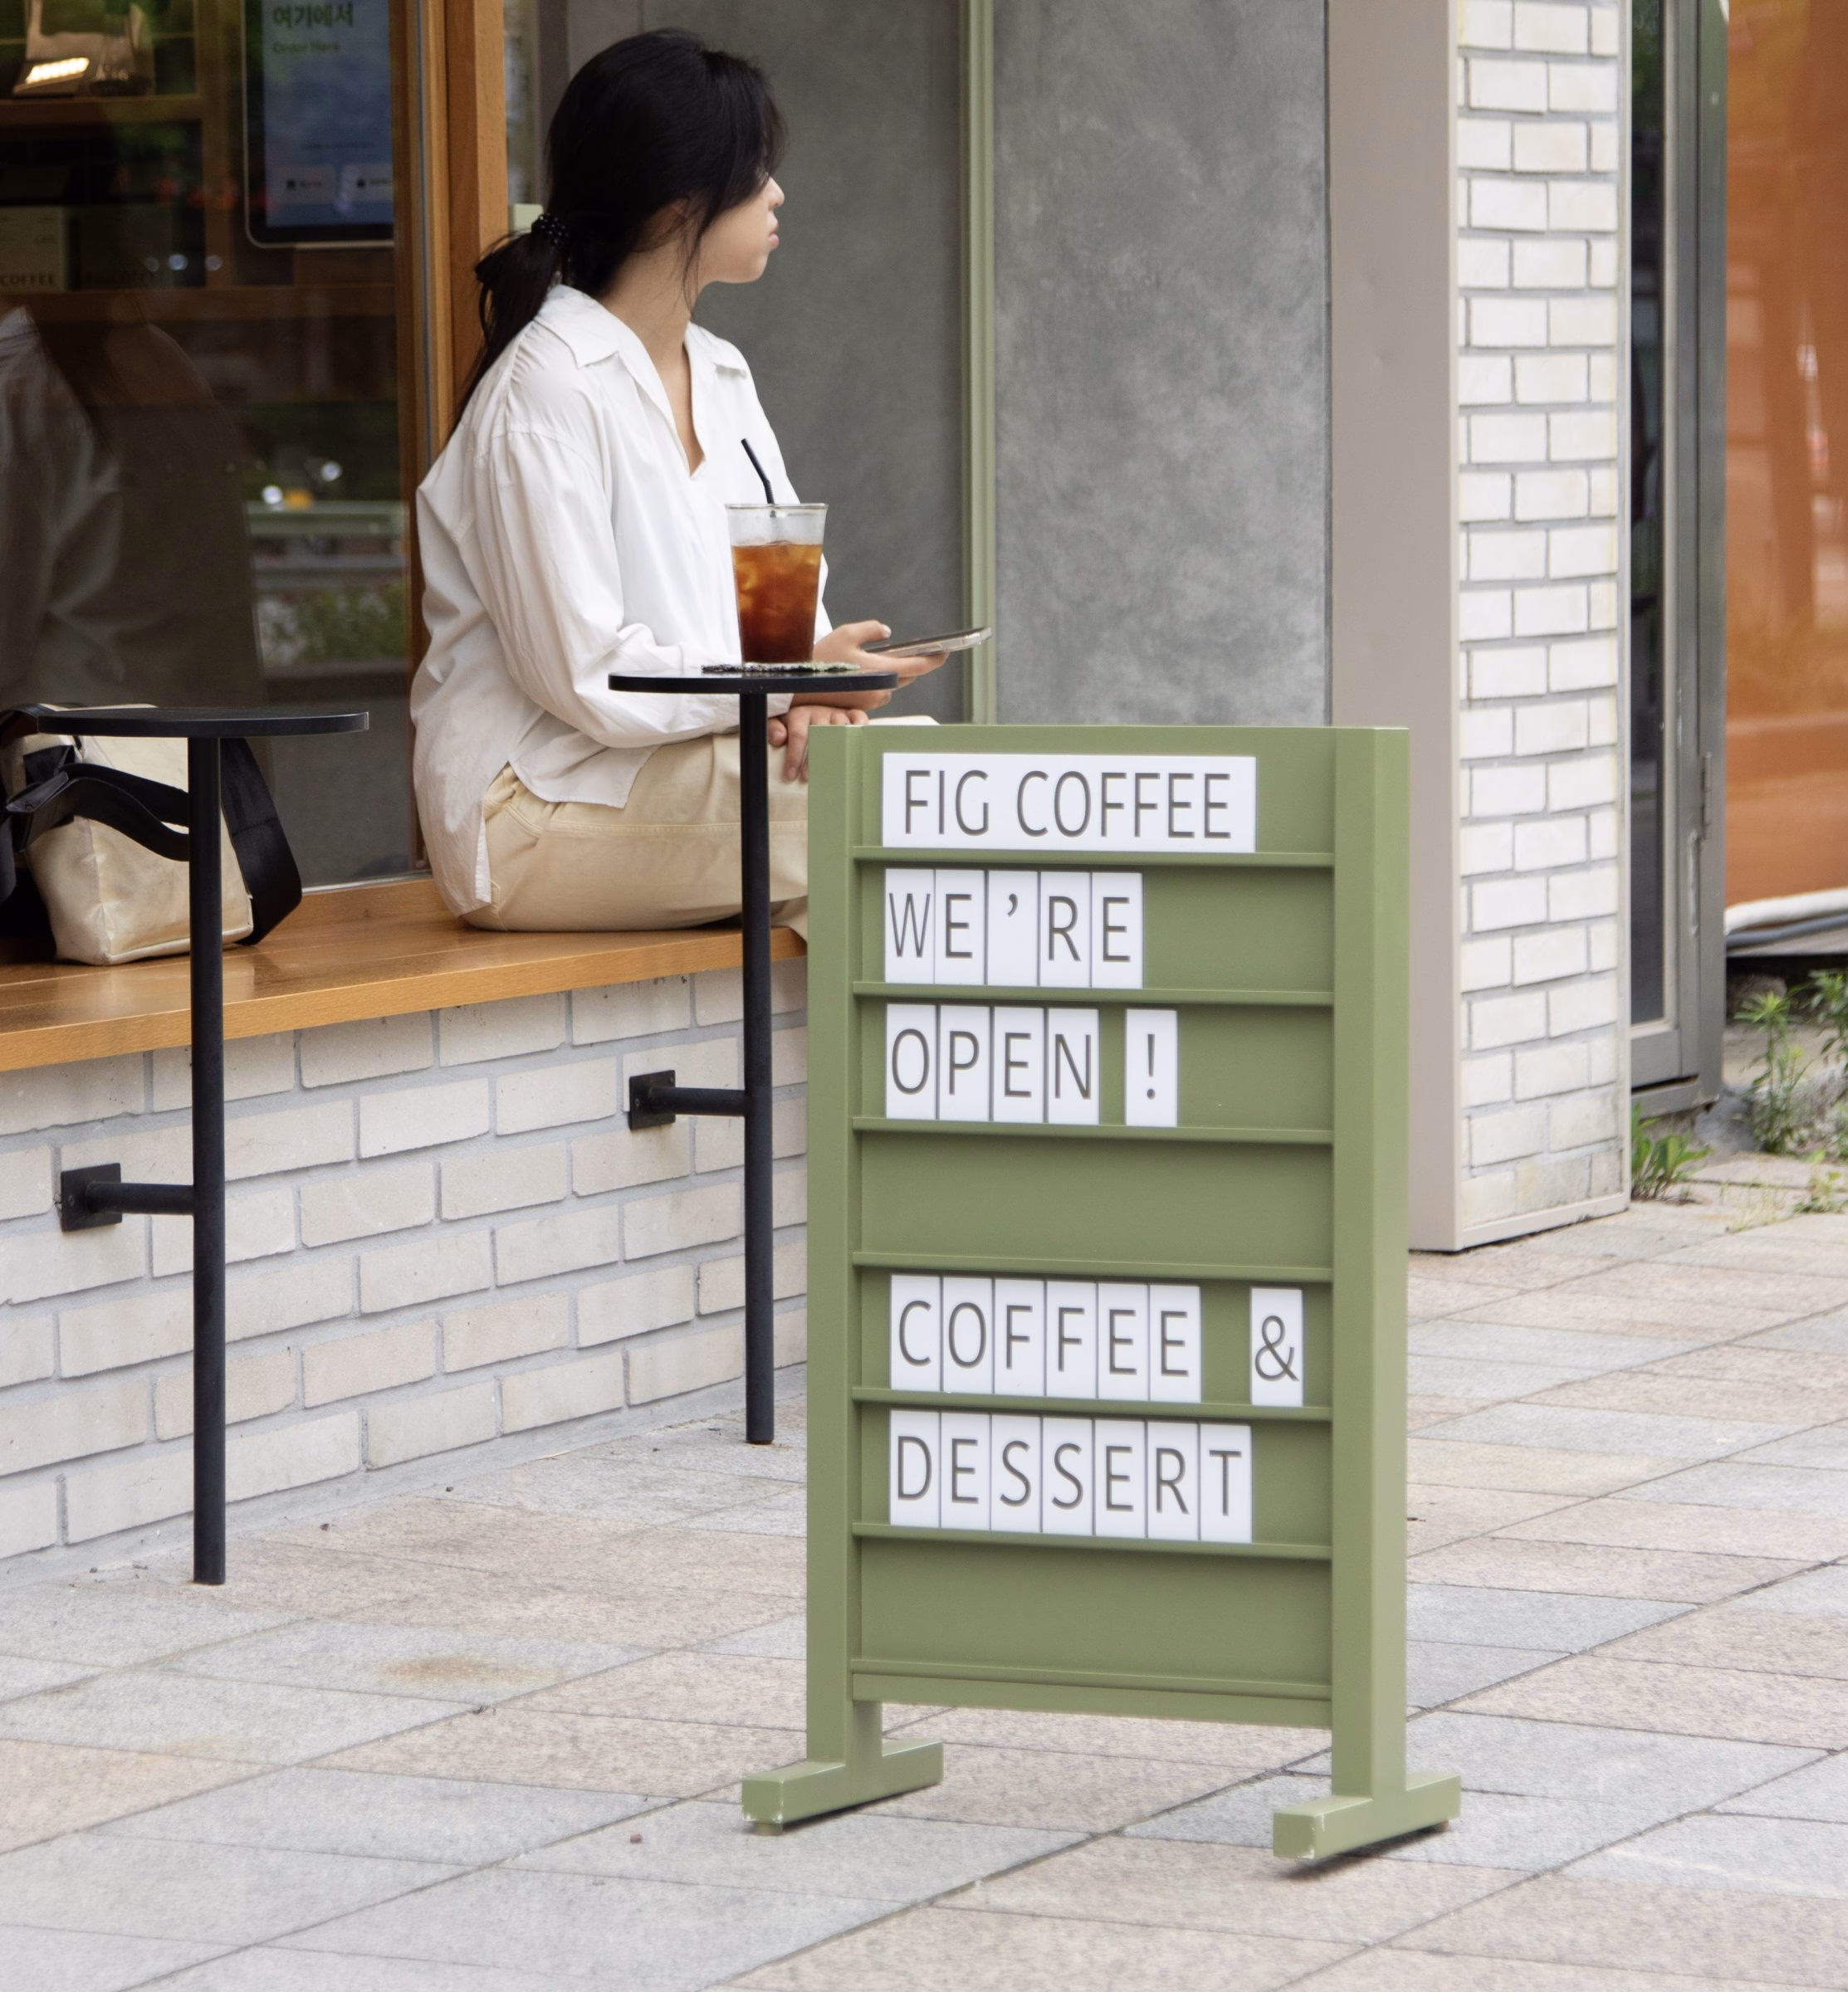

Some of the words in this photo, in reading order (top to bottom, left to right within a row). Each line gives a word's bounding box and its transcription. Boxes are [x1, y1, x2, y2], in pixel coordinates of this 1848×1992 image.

[272, 2, 354, 28] 여기에서
[905, 769, 989, 836] FIG
[1017, 770, 1231, 839] COFFEE
[892, 1028, 1092, 1100] OPEN
[898, 1300, 1189, 1377] COFFEE
[1254, 1315, 1298, 1382] &
[897, 1436, 1242, 1516] DESSERT
